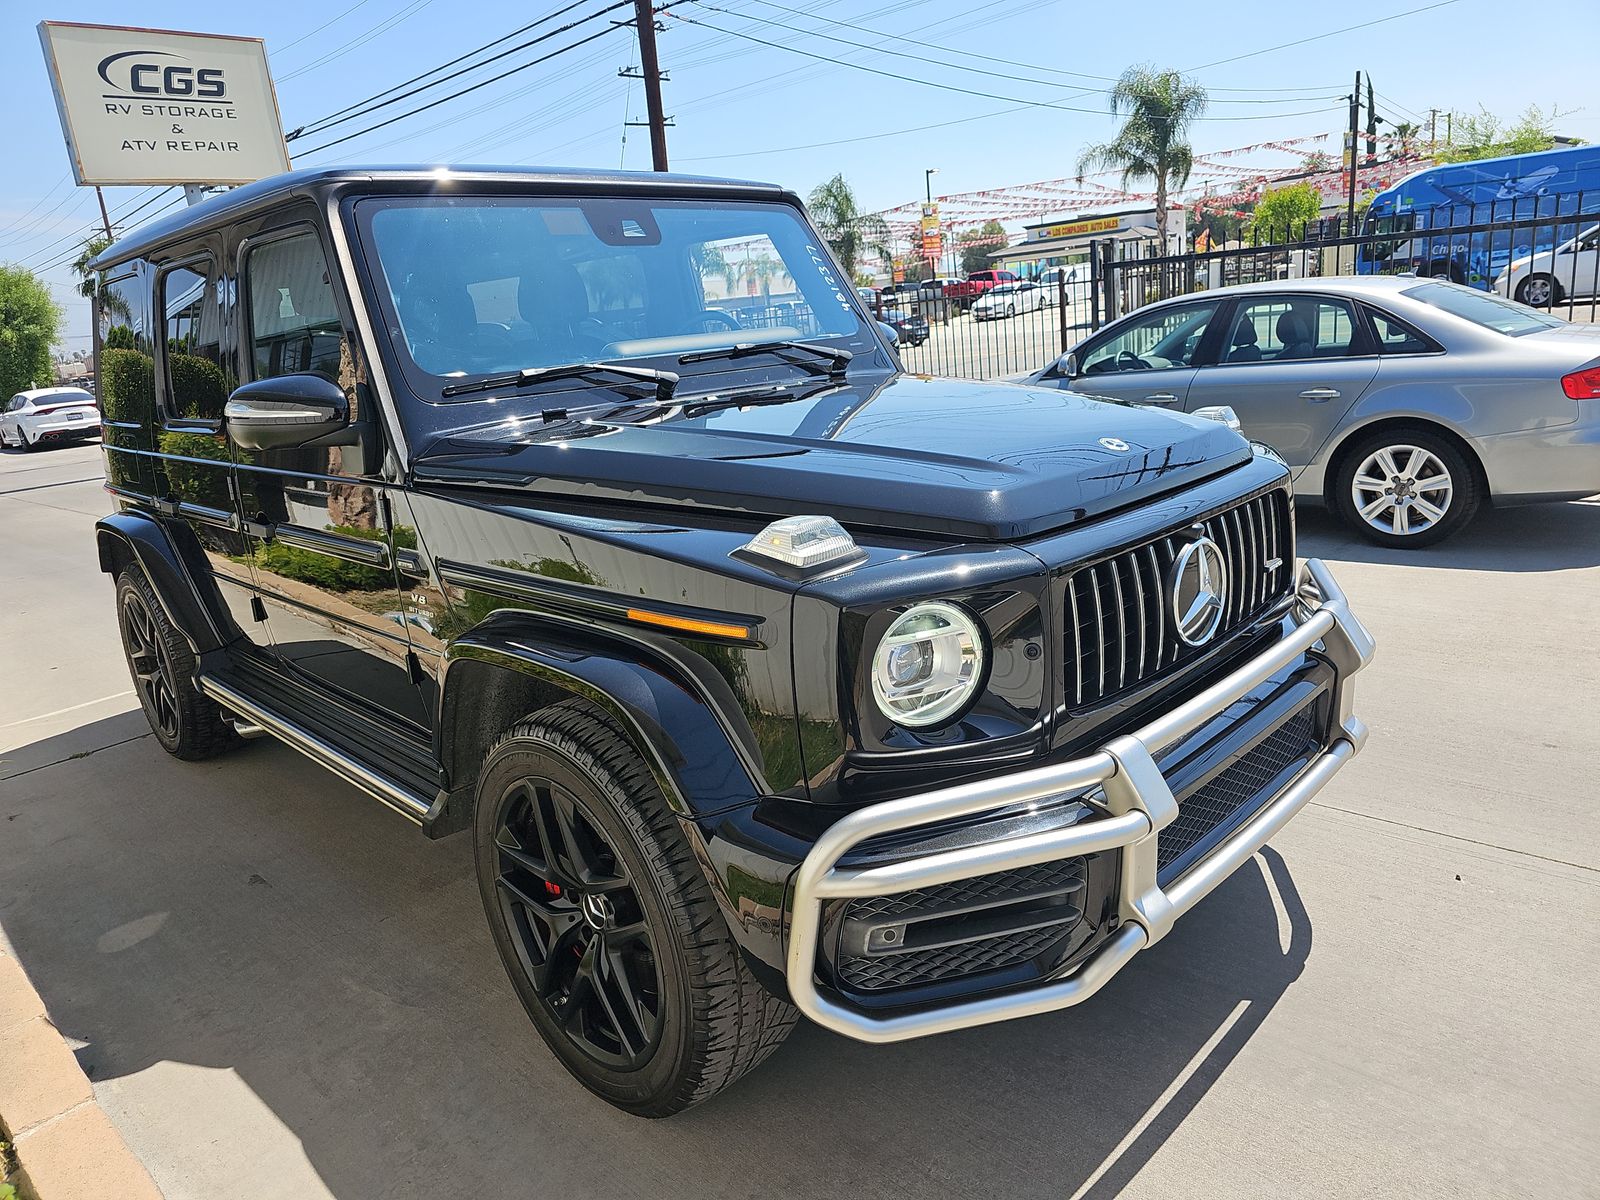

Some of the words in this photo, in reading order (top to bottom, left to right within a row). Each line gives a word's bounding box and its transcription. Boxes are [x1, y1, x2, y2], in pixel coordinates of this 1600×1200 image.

[130, 63, 226, 98] CGS
[105, 103, 131, 115] RV
[142, 105, 238, 119] STORAGE
[171, 123, 184, 134] &
[121, 140, 157, 151] ATV
[167, 141, 240, 152] REPAIR
[1103, 218, 1118, 229] SALES
[410, 593, 427, 605] V8
